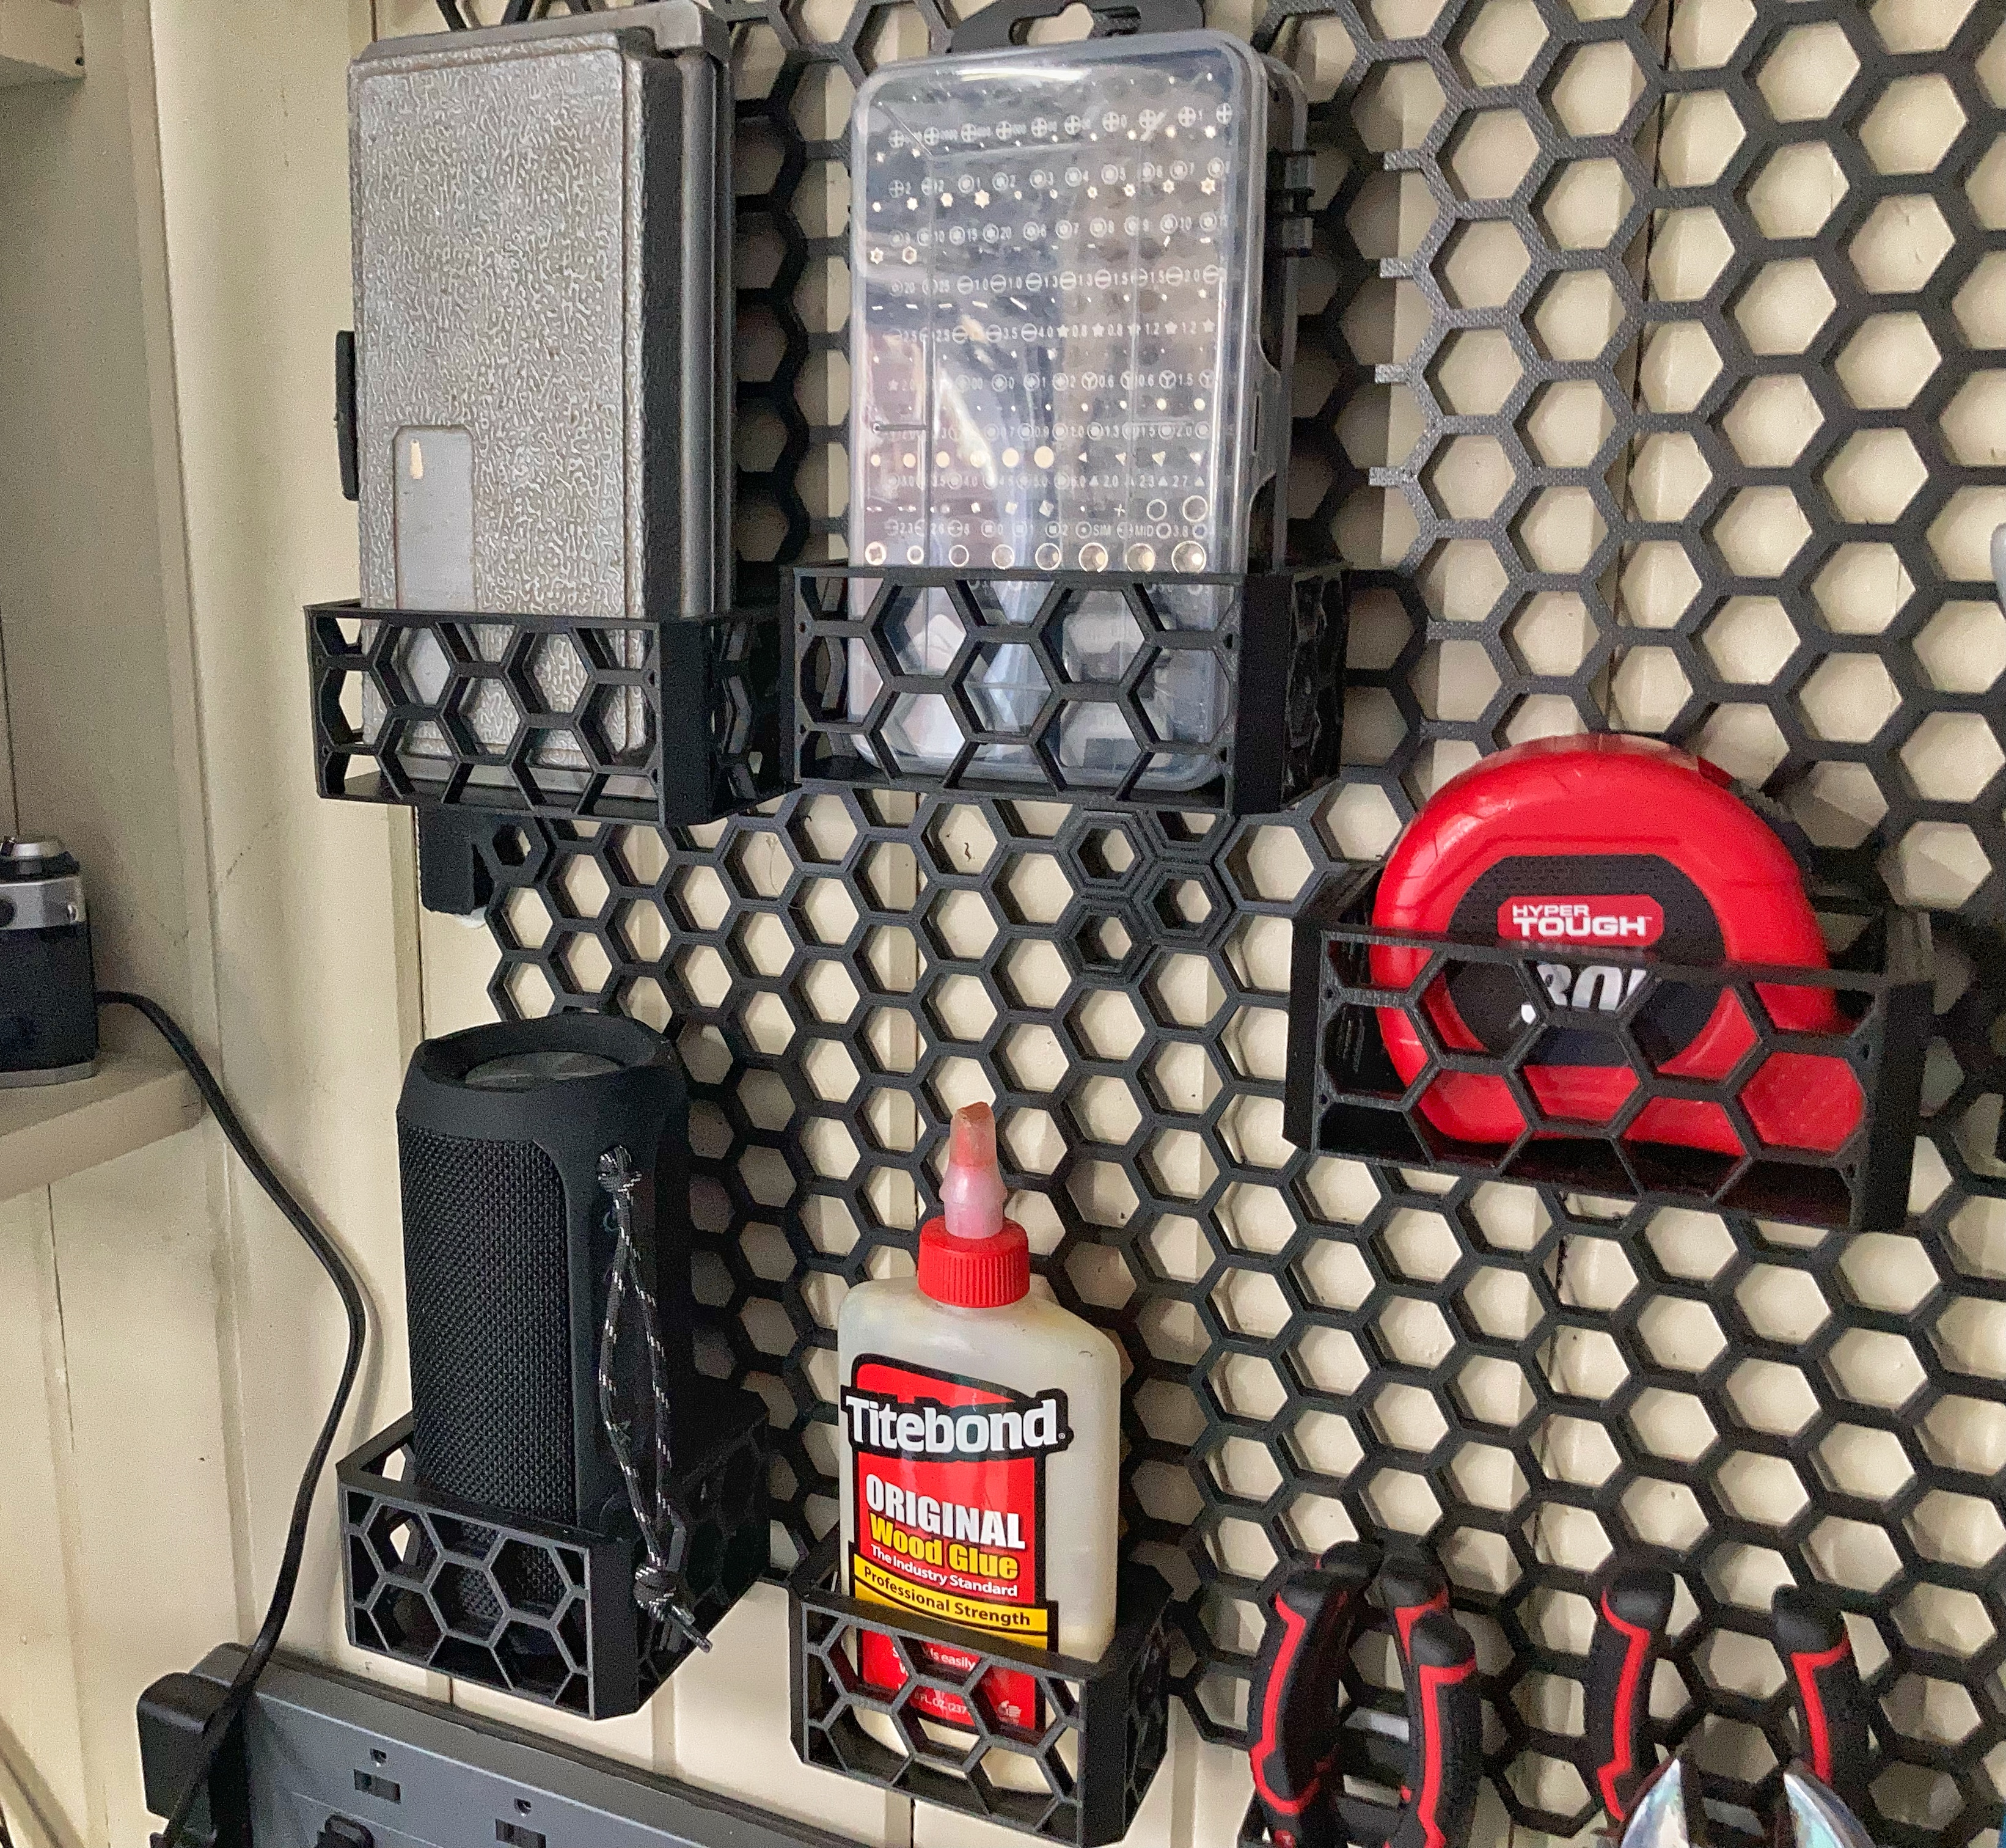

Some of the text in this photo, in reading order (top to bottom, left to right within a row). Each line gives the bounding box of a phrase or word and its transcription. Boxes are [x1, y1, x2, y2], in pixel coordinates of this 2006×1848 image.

[1120, 114, 1127, 129] 0
[1009, 174, 1016, 188] 2
[1047, 171, 1053, 186] 3
[934, 230, 945, 243] 10
[1180, 216, 1192, 231] 10
[1008, 376, 1014, 389] 0
[1042, 376, 1046, 387] 1
[1093, 524, 1111, 537] SIM
[1135, 524, 1154, 537] MID
[1173, 524, 1188, 538] 3.8
[1512, 904, 1589, 917] HYPER
[1512, 916, 1647, 937] TOUGH
[866, 1473, 1026, 1550] ORIGINAL
[868, 1513, 1019, 1580] Wood Glue
[871, 1544, 1018, 1597] The Industry Standard
[863, 1564, 1031, 1627] Professional Strength
[941, 1654, 976, 1672] easily
